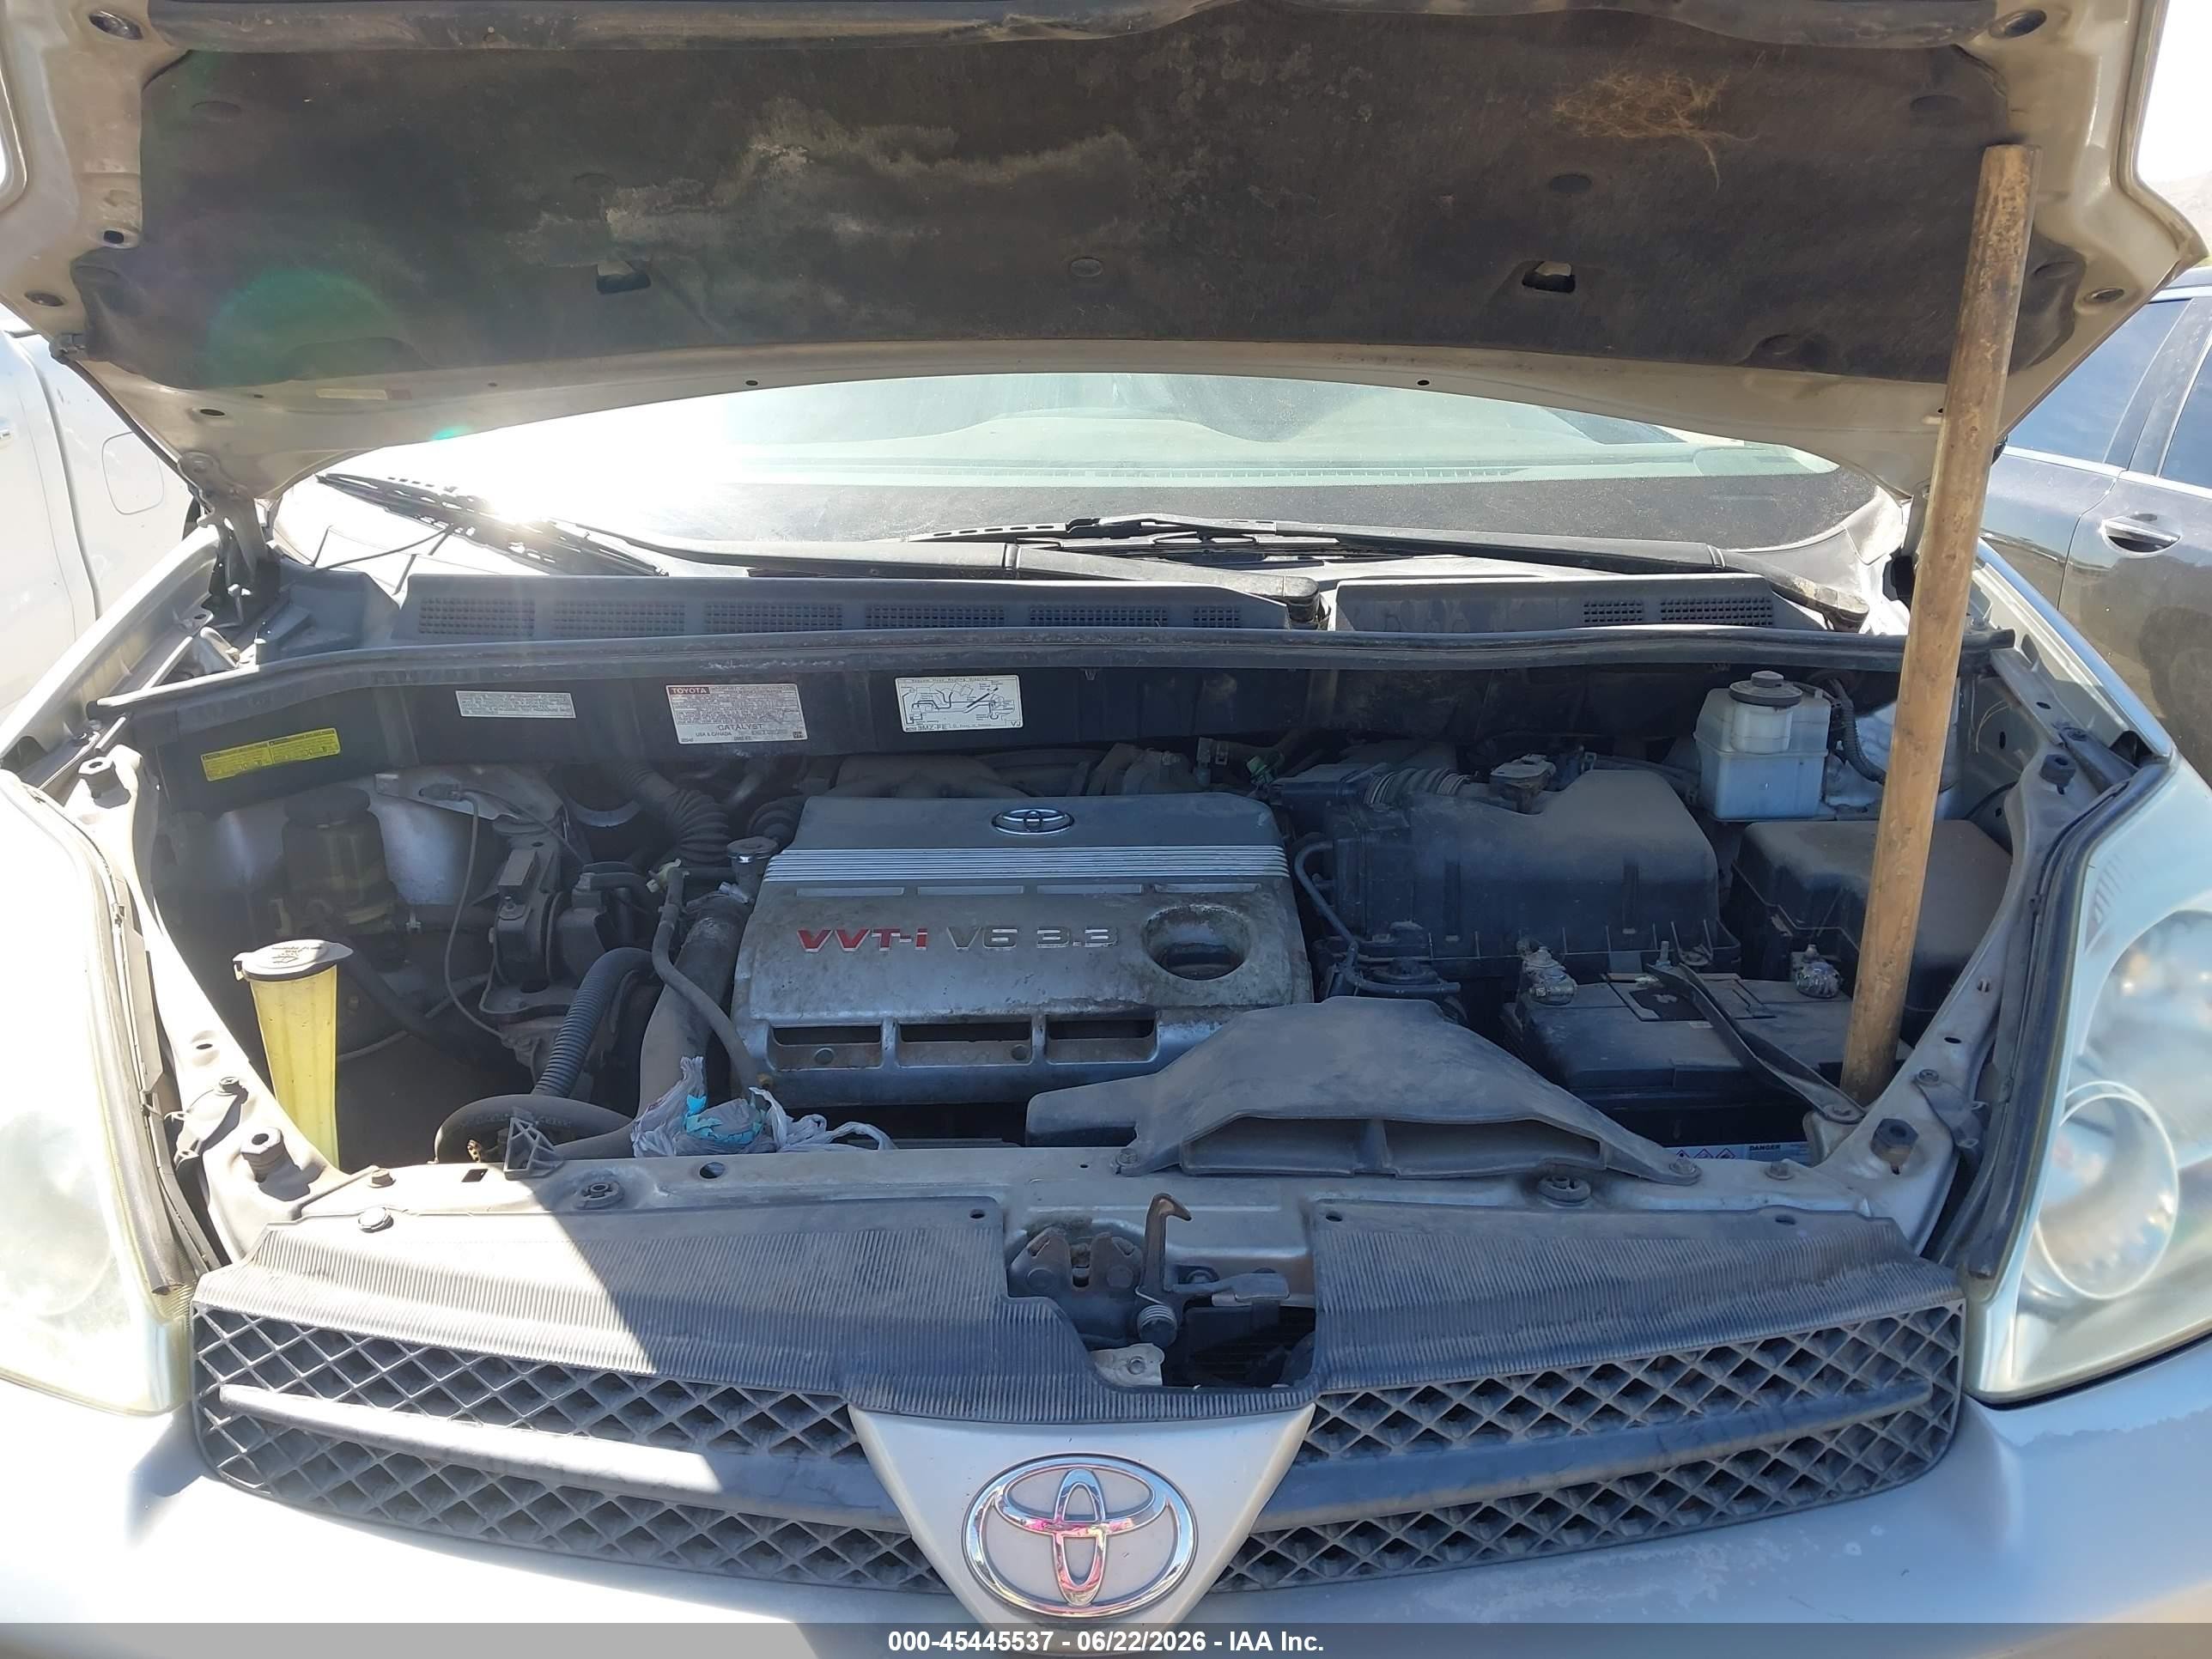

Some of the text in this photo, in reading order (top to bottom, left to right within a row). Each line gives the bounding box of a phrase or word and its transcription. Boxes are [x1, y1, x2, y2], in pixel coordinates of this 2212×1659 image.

[796, 926, 1117, 952] VVT-i V6 3.3
